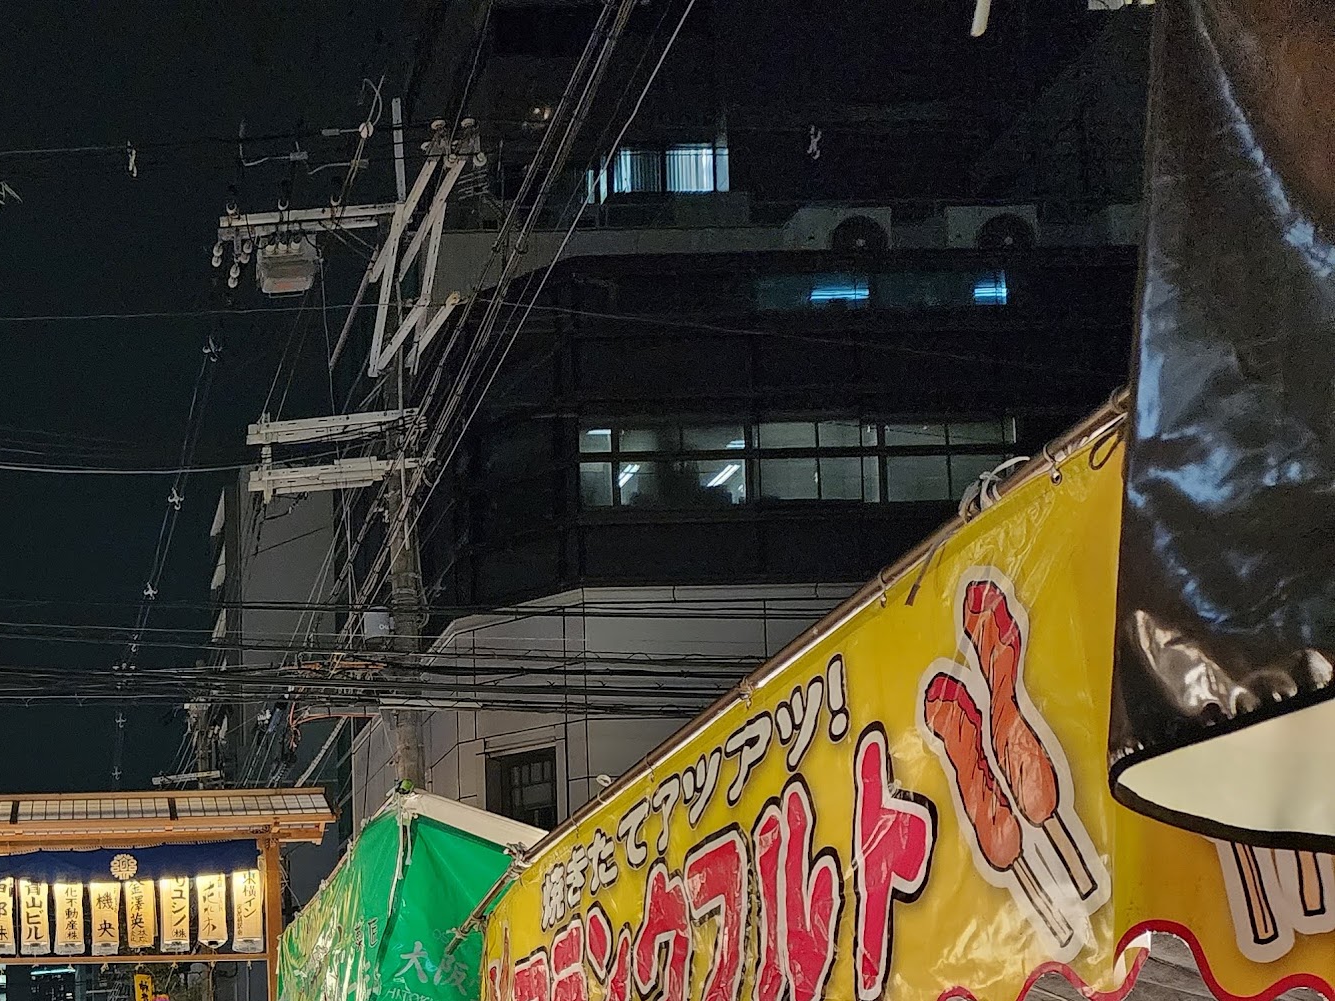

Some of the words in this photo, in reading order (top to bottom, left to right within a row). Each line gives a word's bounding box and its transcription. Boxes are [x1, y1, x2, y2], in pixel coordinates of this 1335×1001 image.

[540, 654, 851, 930] 焼きたてアツアツ!
[394, 941, 469, 997] 大阪
